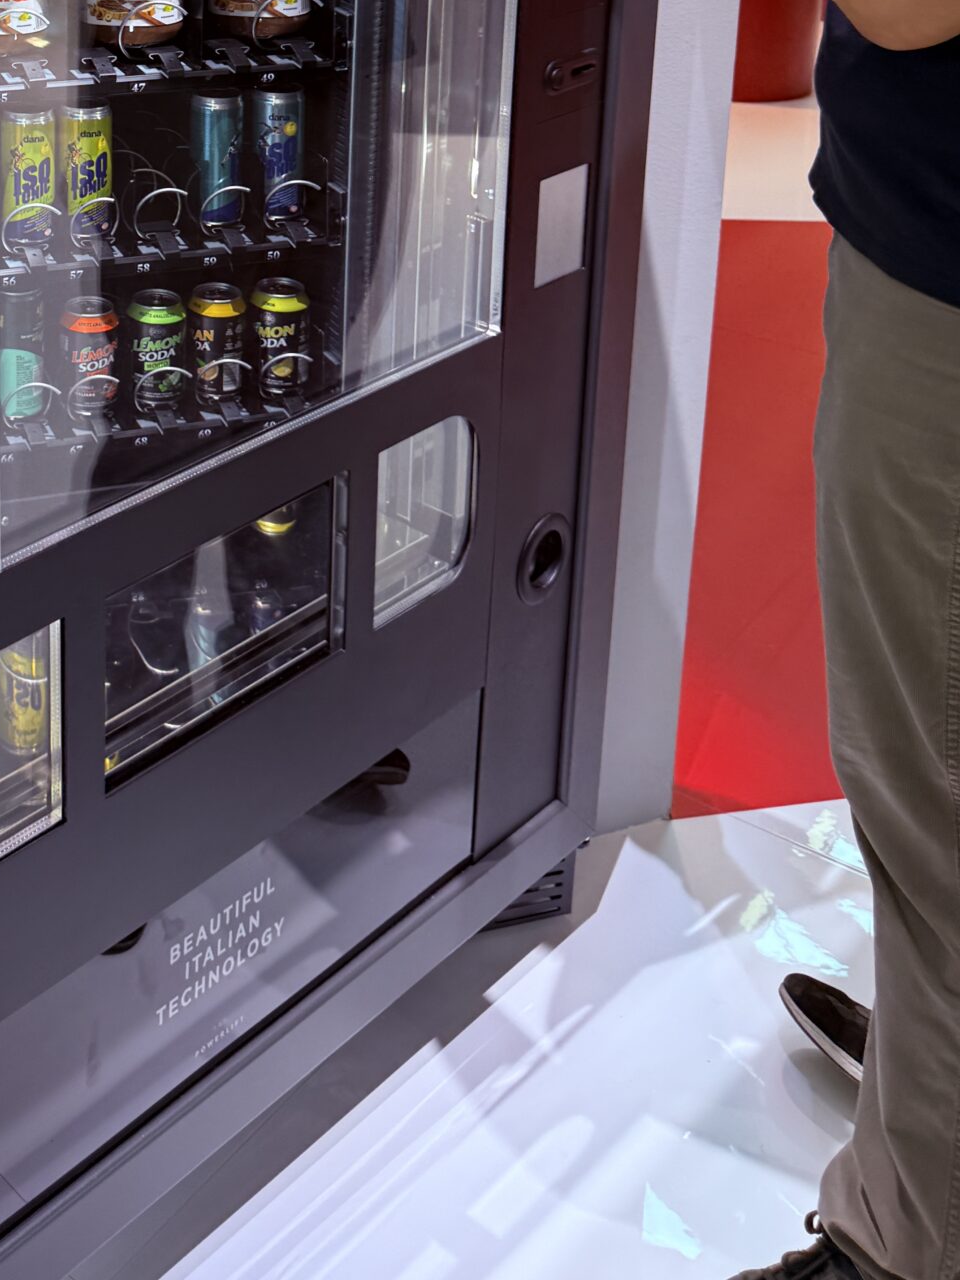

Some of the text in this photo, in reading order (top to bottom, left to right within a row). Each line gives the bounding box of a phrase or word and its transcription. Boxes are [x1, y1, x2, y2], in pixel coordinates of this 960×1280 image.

[260, 72, 275, 83] 49
[131, 82, 146, 93] 47
[22, 135, 46, 144] dana
[80, 130, 102, 138] dana
[203, 257, 217, 266] 59
[266, 251, 281, 261] 50
[136, 263, 151, 273] 58
[69, 269, 84, 280] 57
[2, 276, 17, 286] 56
[193, 328, 215, 342] AN
[257, 322, 295, 338] MON
[133, 332, 182, 352] LEMON
[138, 348, 176, 362] SODA
[78, 354, 115, 373] SODA
[198, 428, 212, 438] 69
[134, 436, 149, 447] 68
[0, 454, 14, 464] 66
[170, 877, 276, 965] BEAUTIFUL
[185, 910, 261, 980] ITALIAN
[155, 916, 285, 1026] TECHNOLOGY
